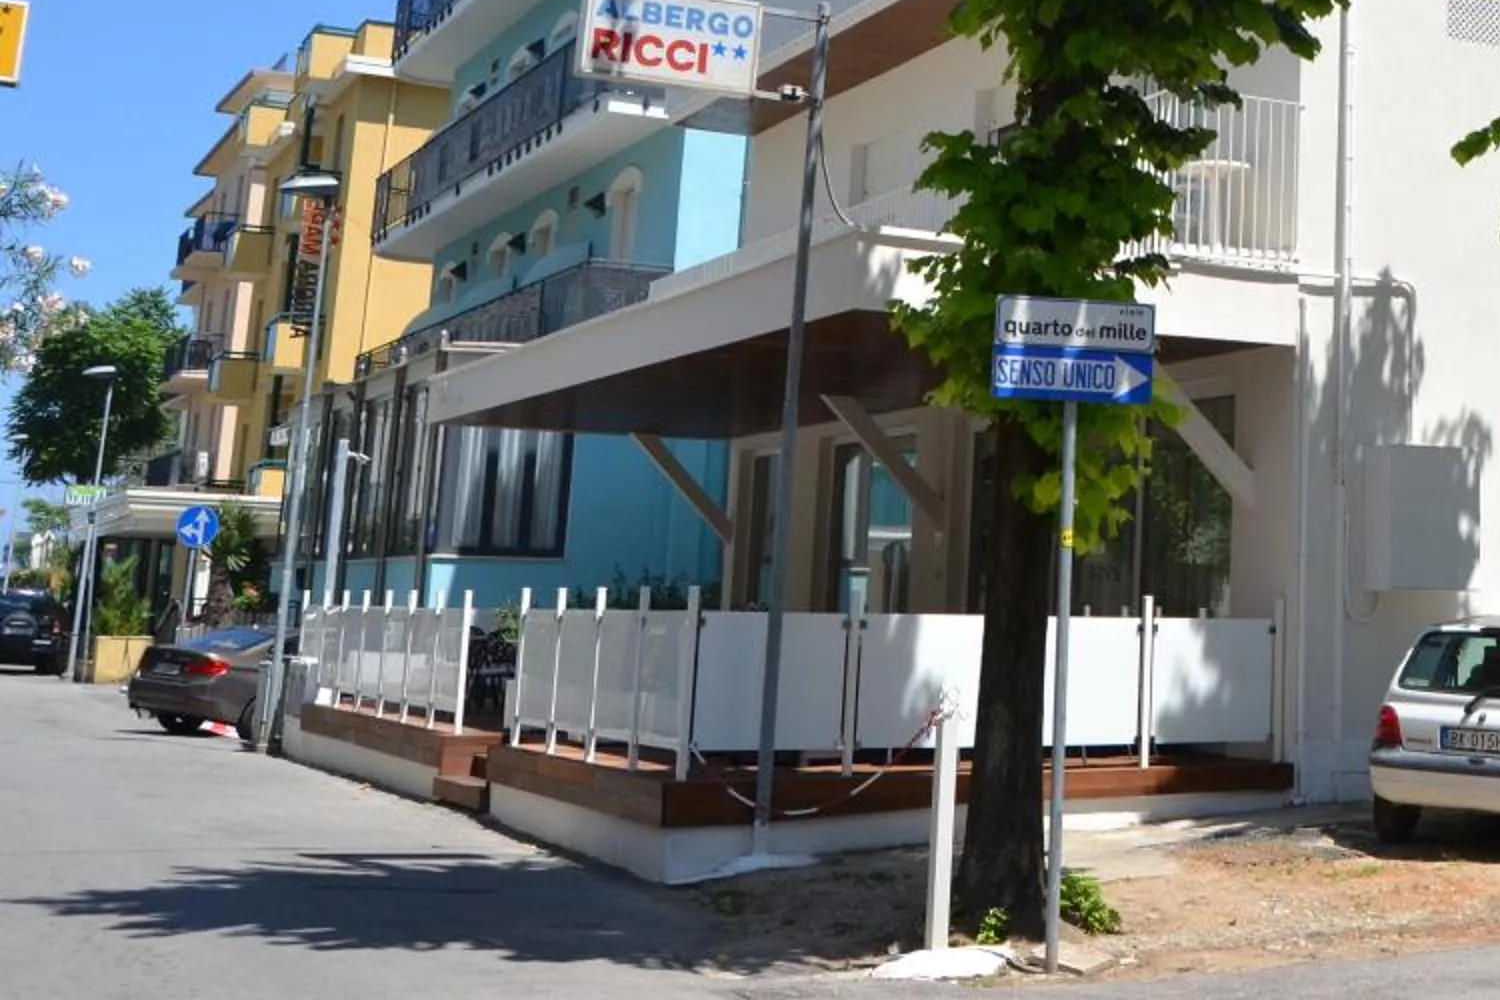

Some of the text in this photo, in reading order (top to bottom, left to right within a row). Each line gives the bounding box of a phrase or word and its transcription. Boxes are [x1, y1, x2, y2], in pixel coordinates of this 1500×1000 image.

[592, 28, 708, 74] RICCI
[1004, 319, 1073, 338] quarto
[1099, 323, 1147, 341] mille
[997, 359, 1115, 390] SENSO UNICO
